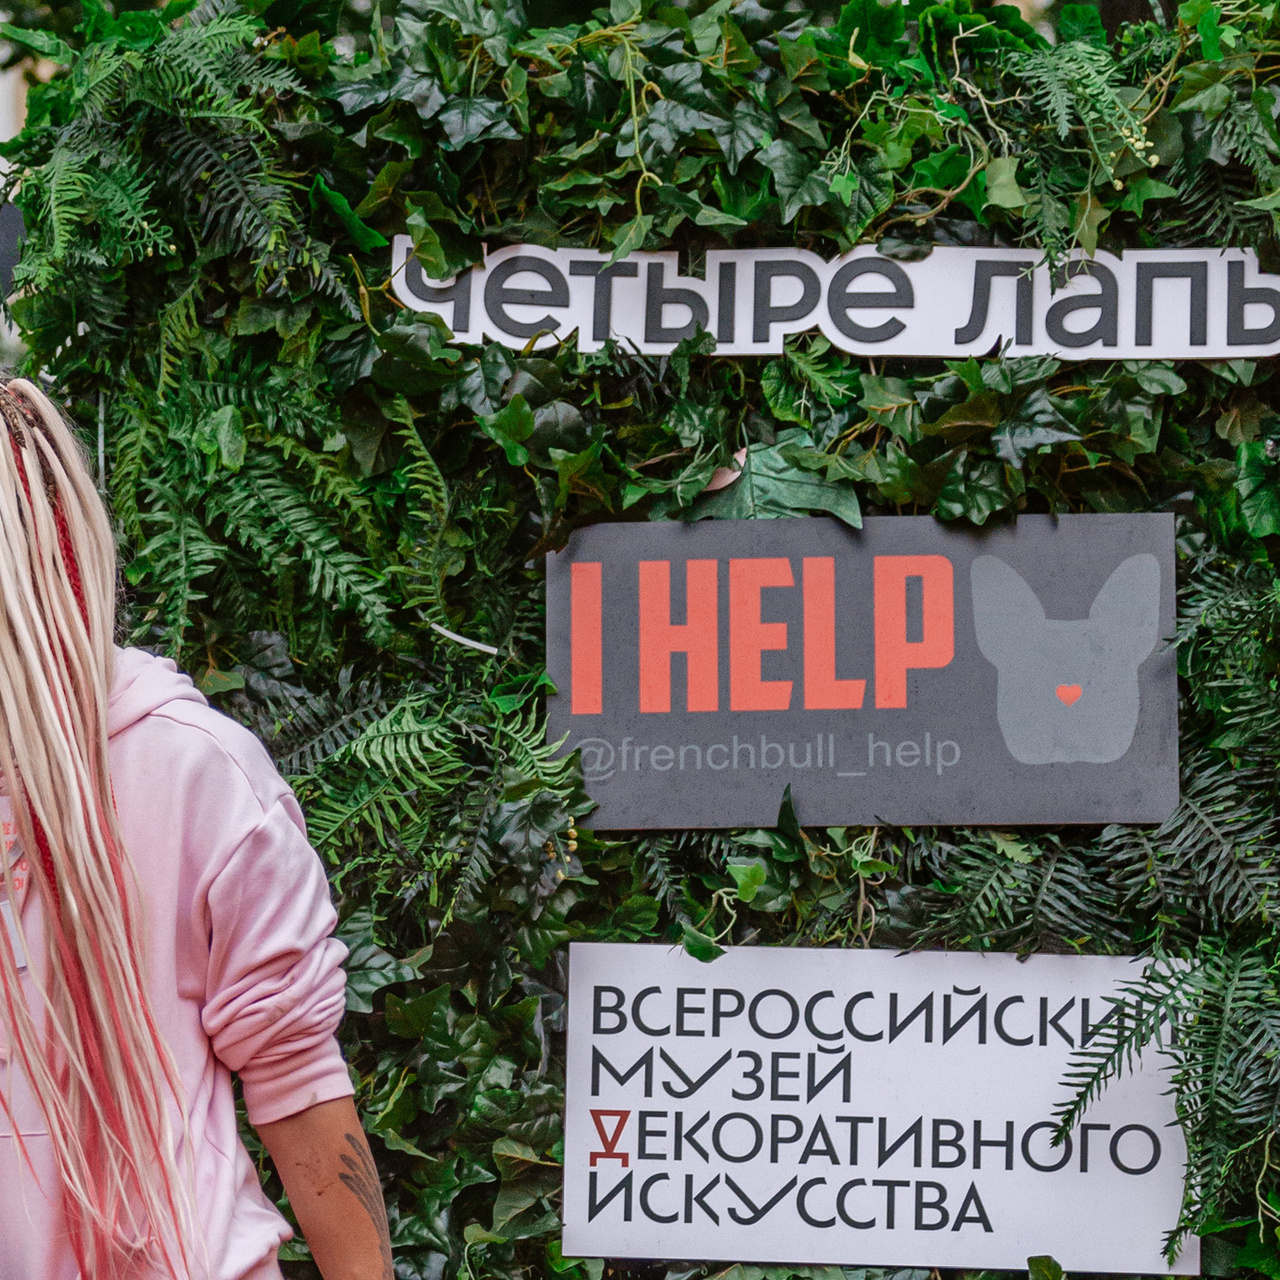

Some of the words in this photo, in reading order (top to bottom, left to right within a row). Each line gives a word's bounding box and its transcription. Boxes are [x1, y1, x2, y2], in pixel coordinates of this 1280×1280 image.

[404, 246, 916, 345] четыре
[571, 562, 602, 714] I
[639, 555, 954, 712] HELP
[578, 732, 962, 781] @frenchbull_help
[591, 1044, 852, 1104] МУЗЕЙ
[589, 1108, 1161, 1176] ДЕКОРАТИВНОГО
[588, 1172, 994, 1233] ИСКУССТВА
